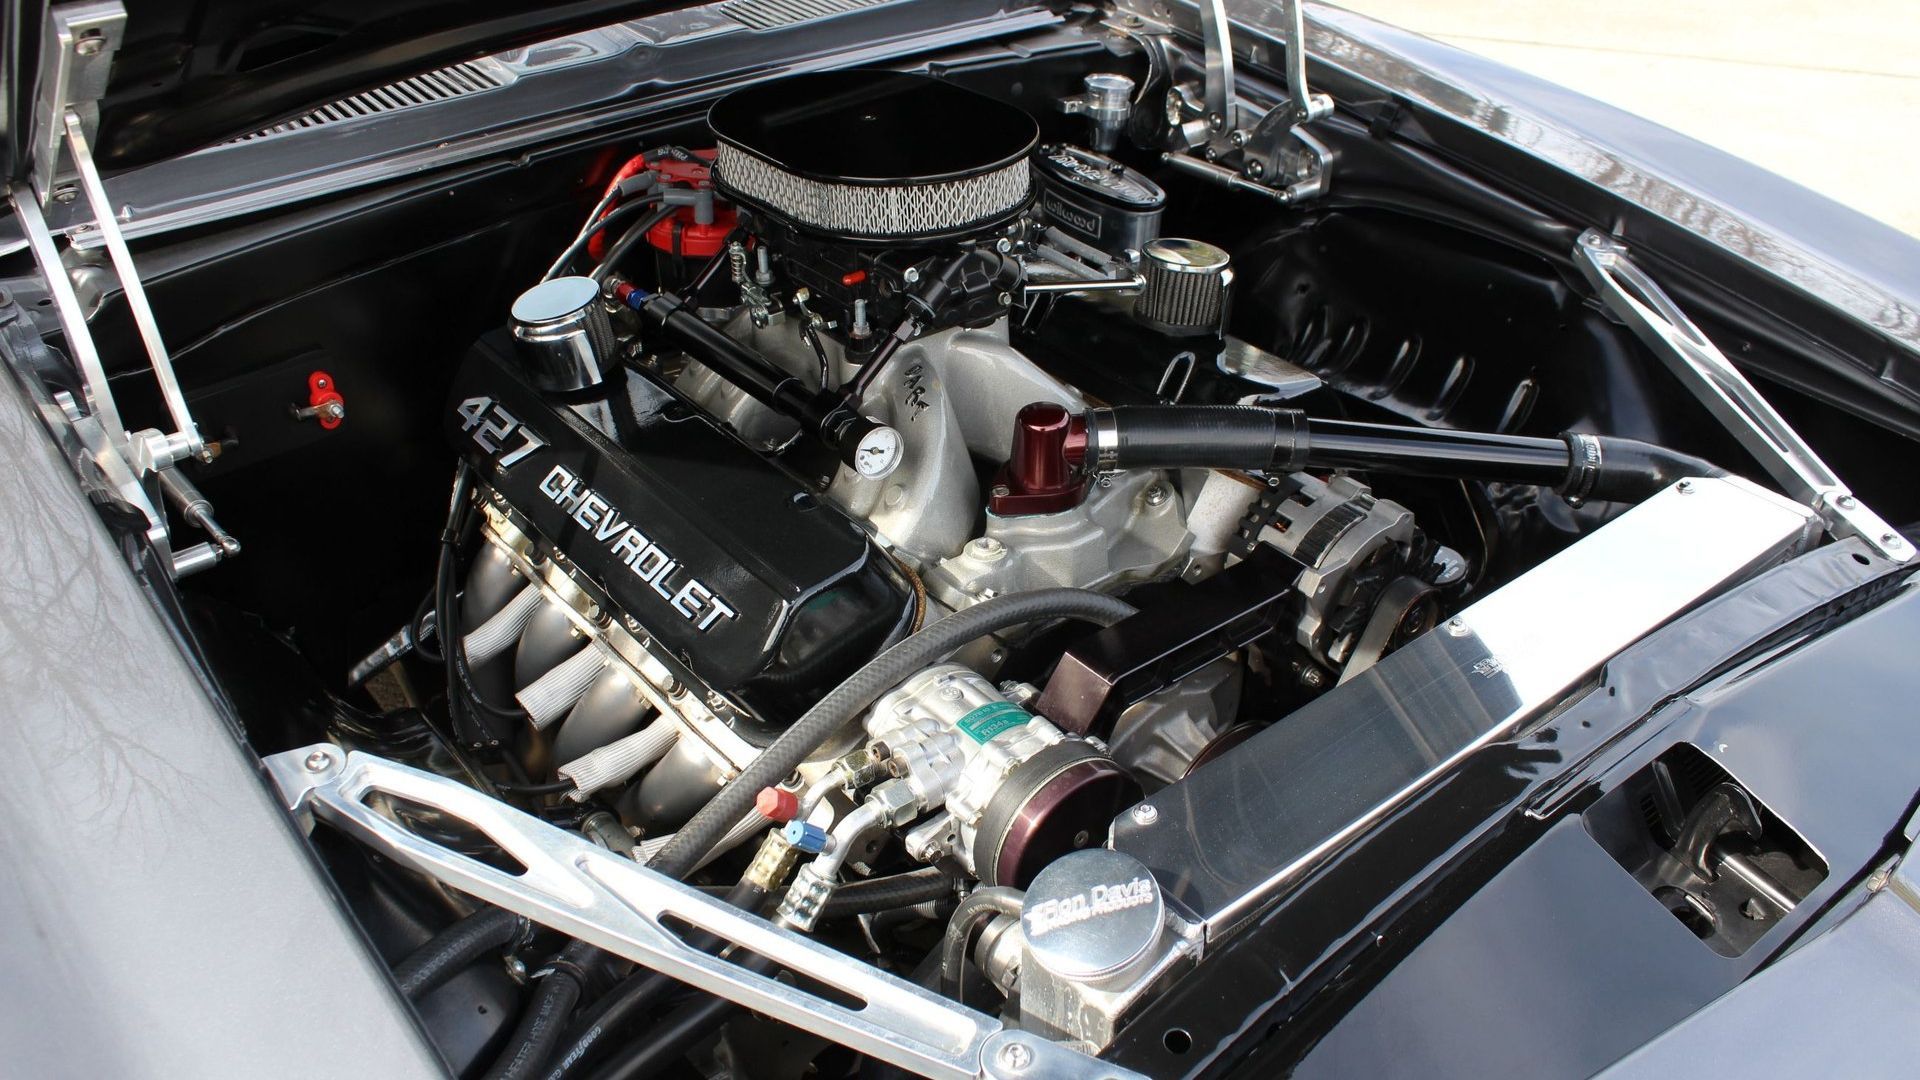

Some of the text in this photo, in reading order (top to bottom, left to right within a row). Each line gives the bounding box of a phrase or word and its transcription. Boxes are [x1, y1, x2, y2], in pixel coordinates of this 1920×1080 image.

[1047, 201, 1096, 232] wilwood
[457, 396, 547, 469] 427
[538, 464, 740, 631] CHEVROLET
[1091, 877, 1152, 904] Davis
[562, 1026, 602, 1070] GOODYEAR
